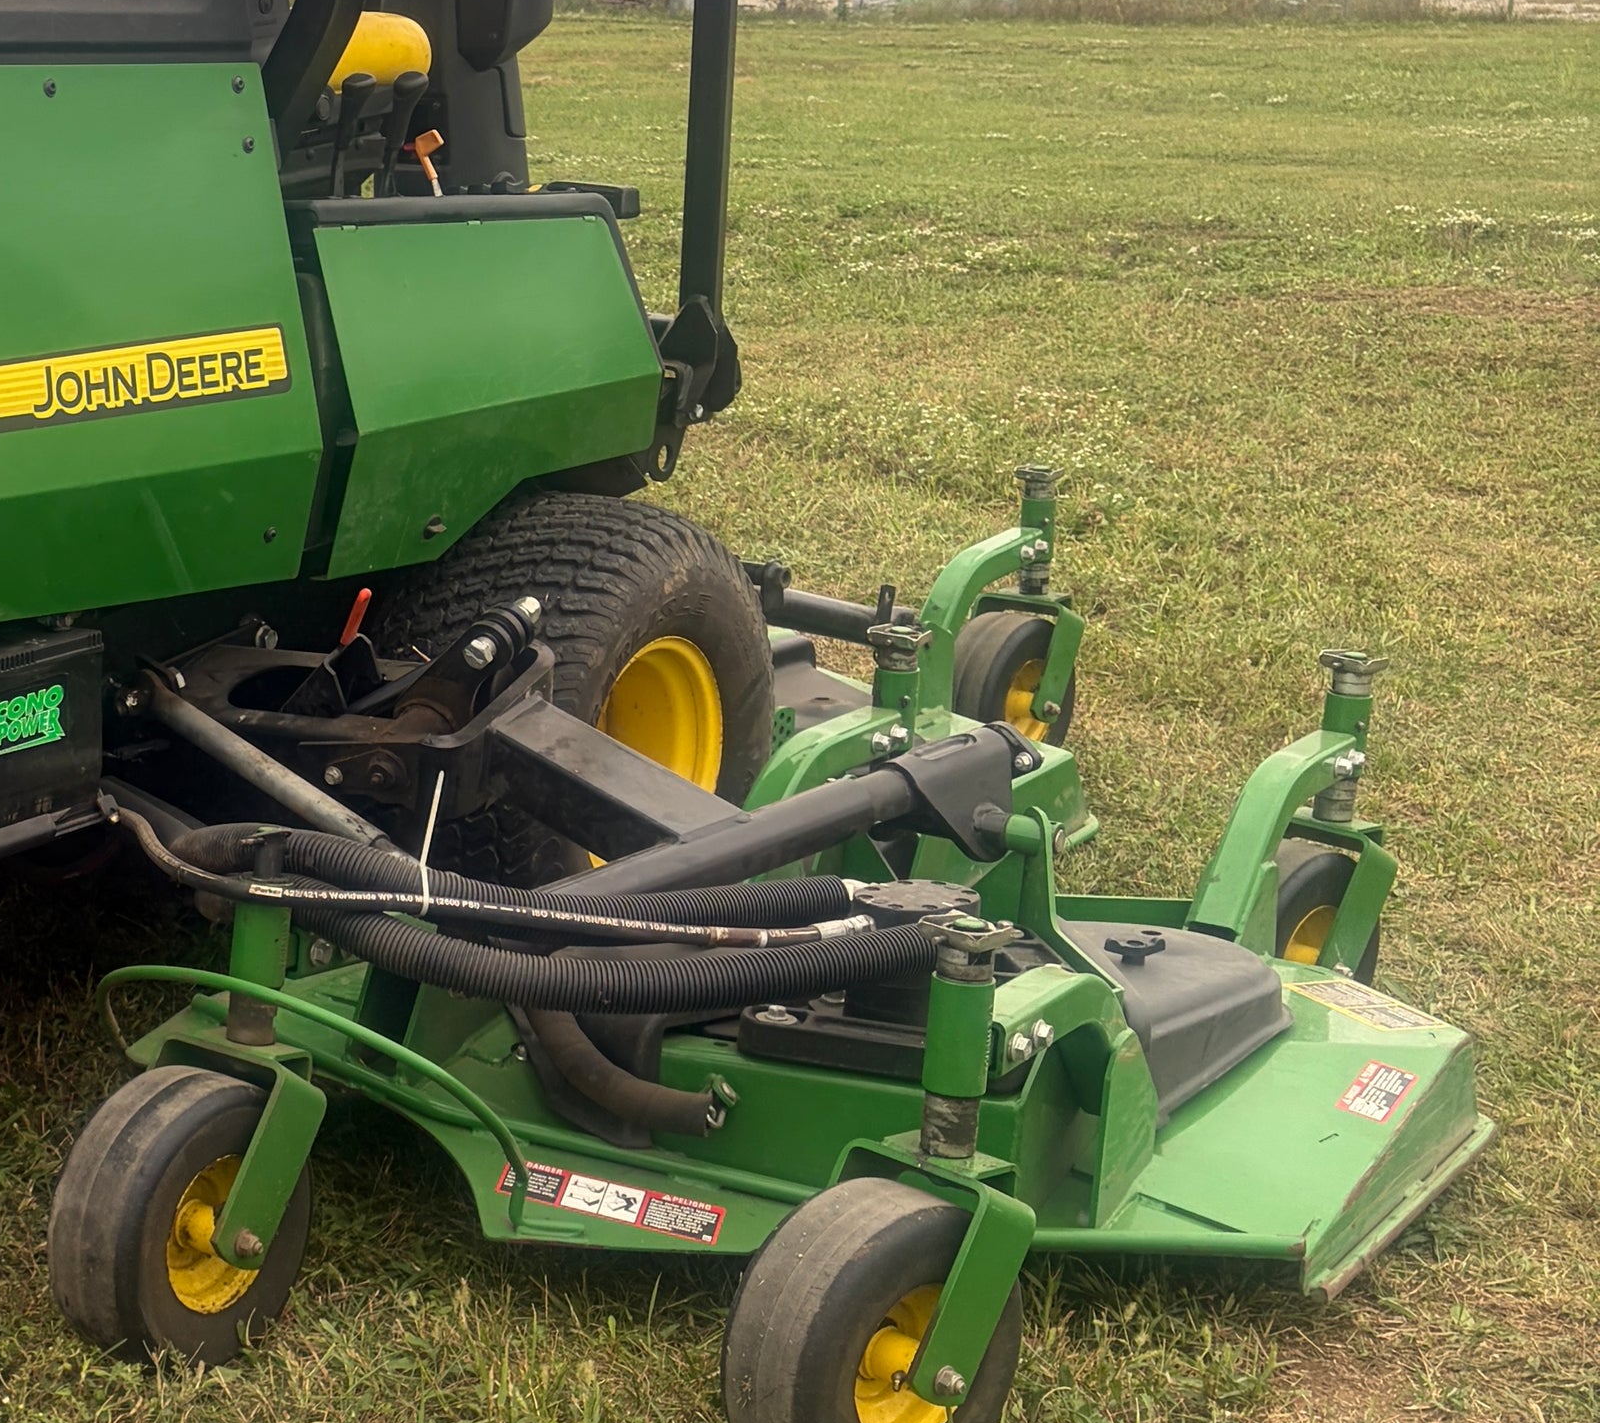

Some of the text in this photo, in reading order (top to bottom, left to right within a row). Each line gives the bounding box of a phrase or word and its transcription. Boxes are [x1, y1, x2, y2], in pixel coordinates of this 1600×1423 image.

[33, 348, 266, 413] JOHN DEERE
[328, 890, 377, 901] Worldwide
[377, 892, 394, 901] WP
[414, 894, 435, 905] Ma
[525, 1161, 564, 1176] DANGER
[671, 1195, 712, 1211] PELIGRO
